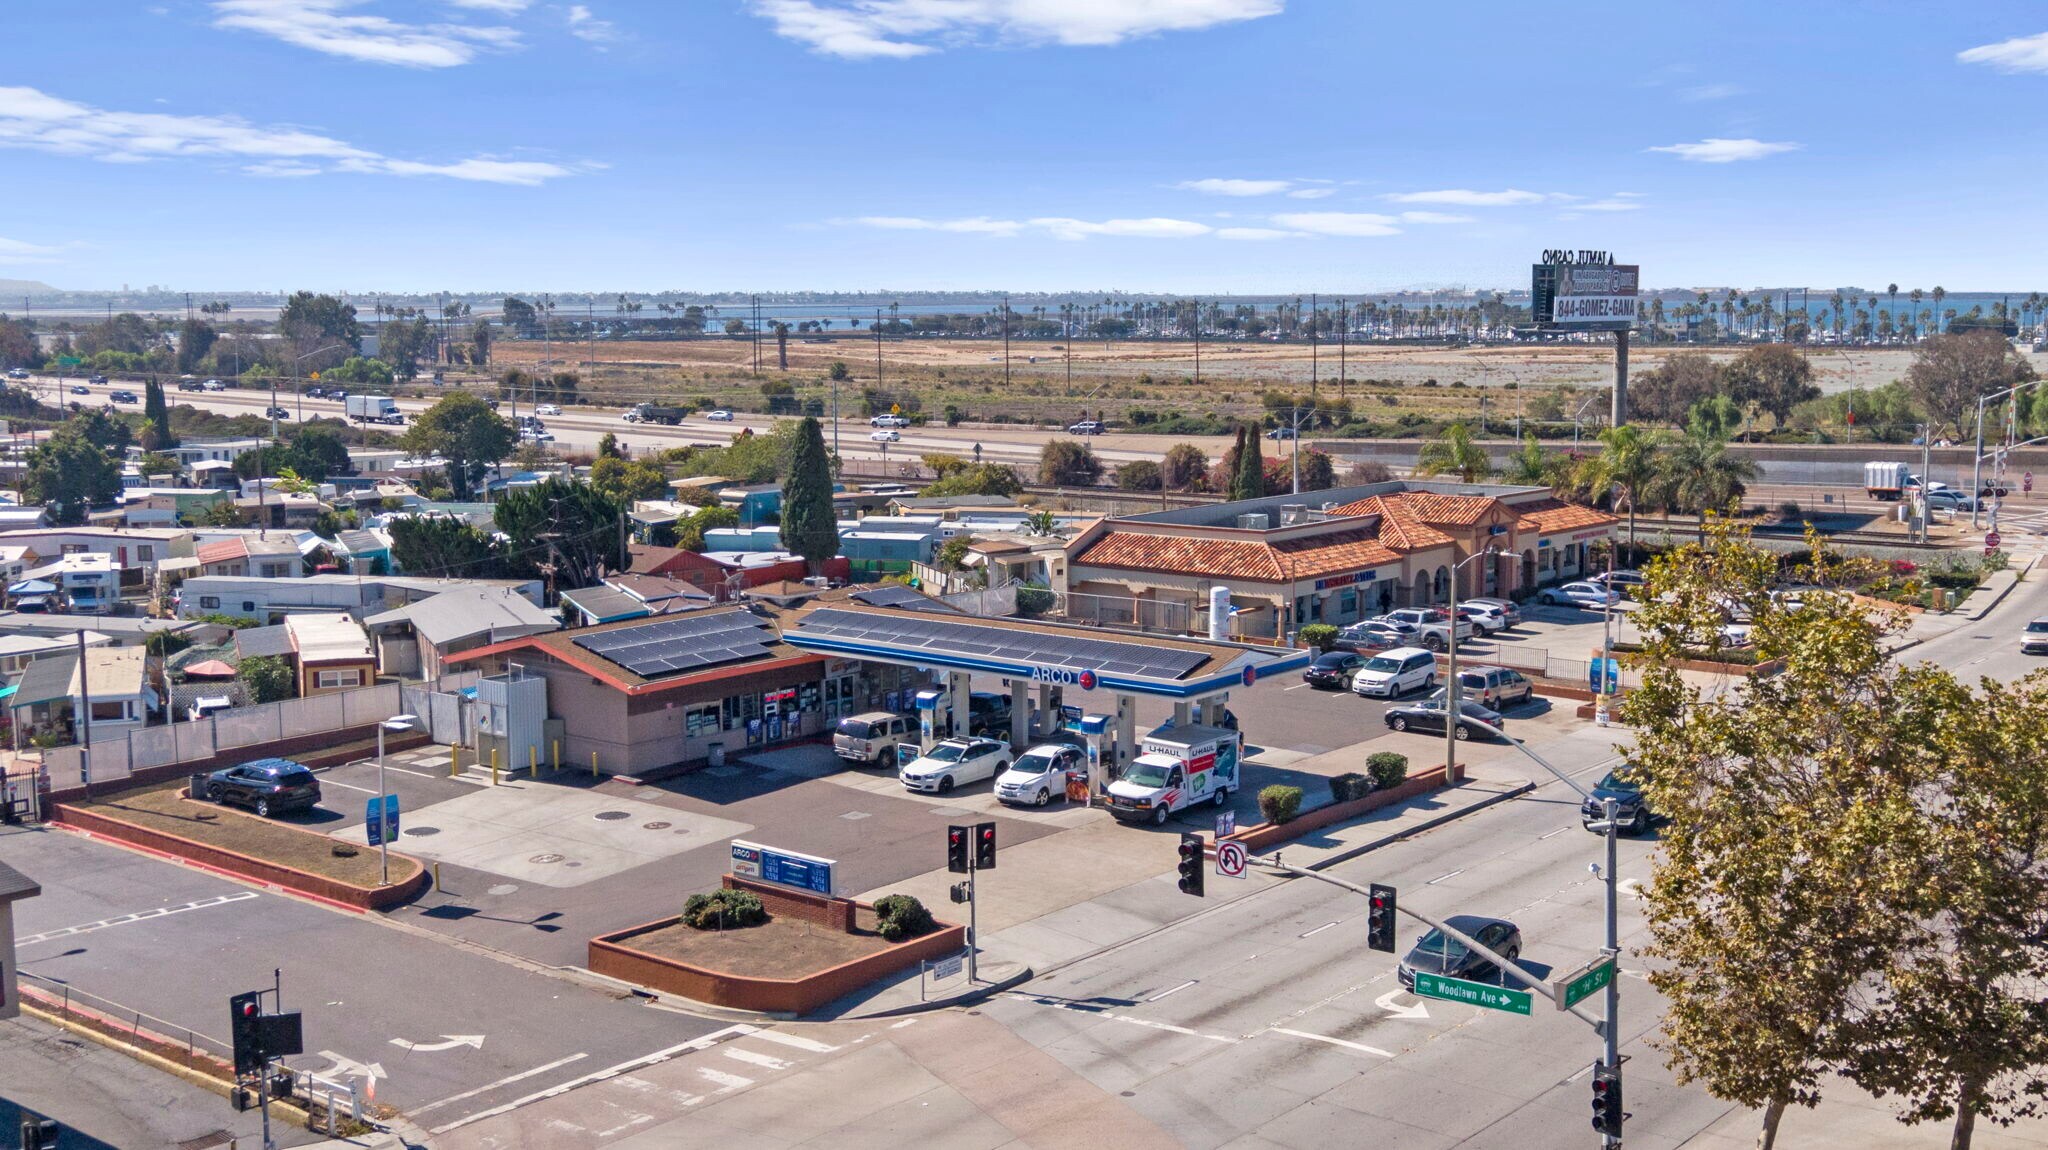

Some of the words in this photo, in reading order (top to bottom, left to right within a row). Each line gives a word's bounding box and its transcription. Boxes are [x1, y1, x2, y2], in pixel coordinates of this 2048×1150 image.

[1558, 299, 1635, 317] 844-GOMEZ-GANA
[1032, 667, 1072, 684] ARCO
[1149, 745, 1182, 757] U-HAUL
[1192, 745, 1215, 757] U-HAUL
[733, 848, 750, 859] ARCO
[736, 864, 755, 873] ampm
[1594, 972, 1603, 986] St
[1438, 981, 1477, 1000] Woodlawn
[1480, 990, 1497, 1004] Ave
